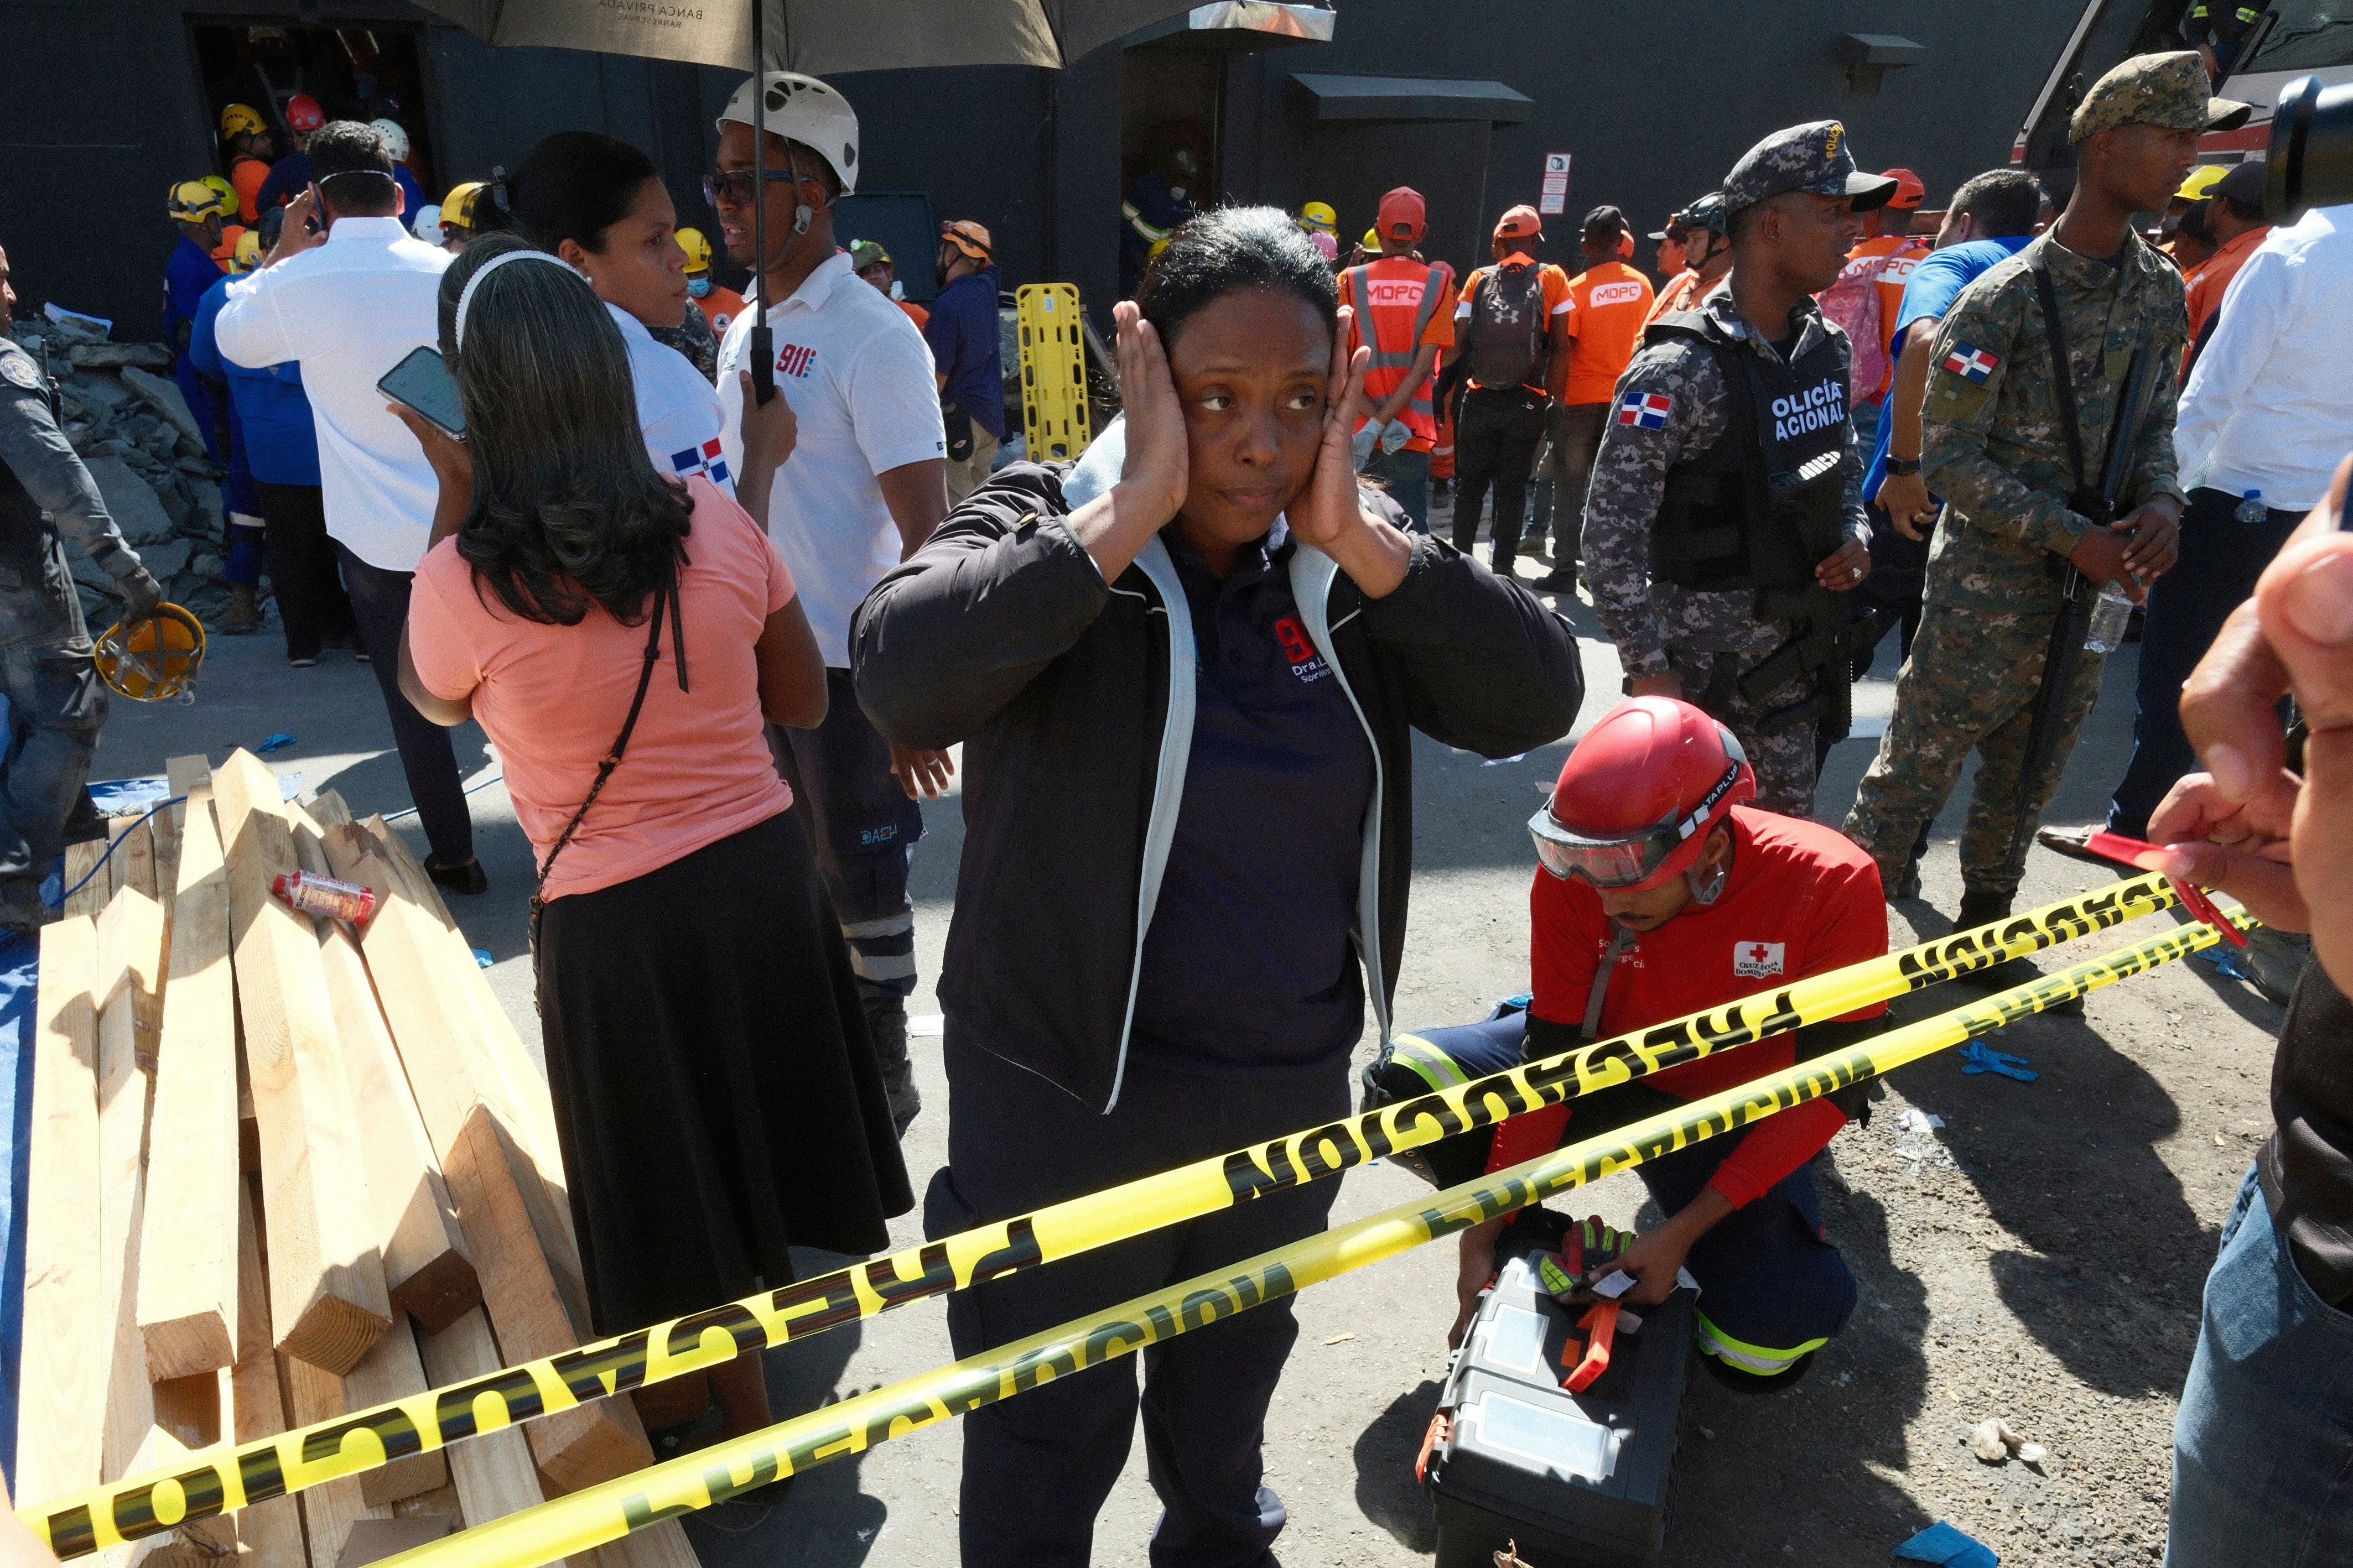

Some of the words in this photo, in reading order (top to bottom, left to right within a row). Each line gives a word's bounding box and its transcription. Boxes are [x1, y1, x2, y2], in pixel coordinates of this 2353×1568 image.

[1853, 259, 1915, 275] MPC
[1596, 286, 1638, 301] MOPC
[776, 343, 811, 378] 911
